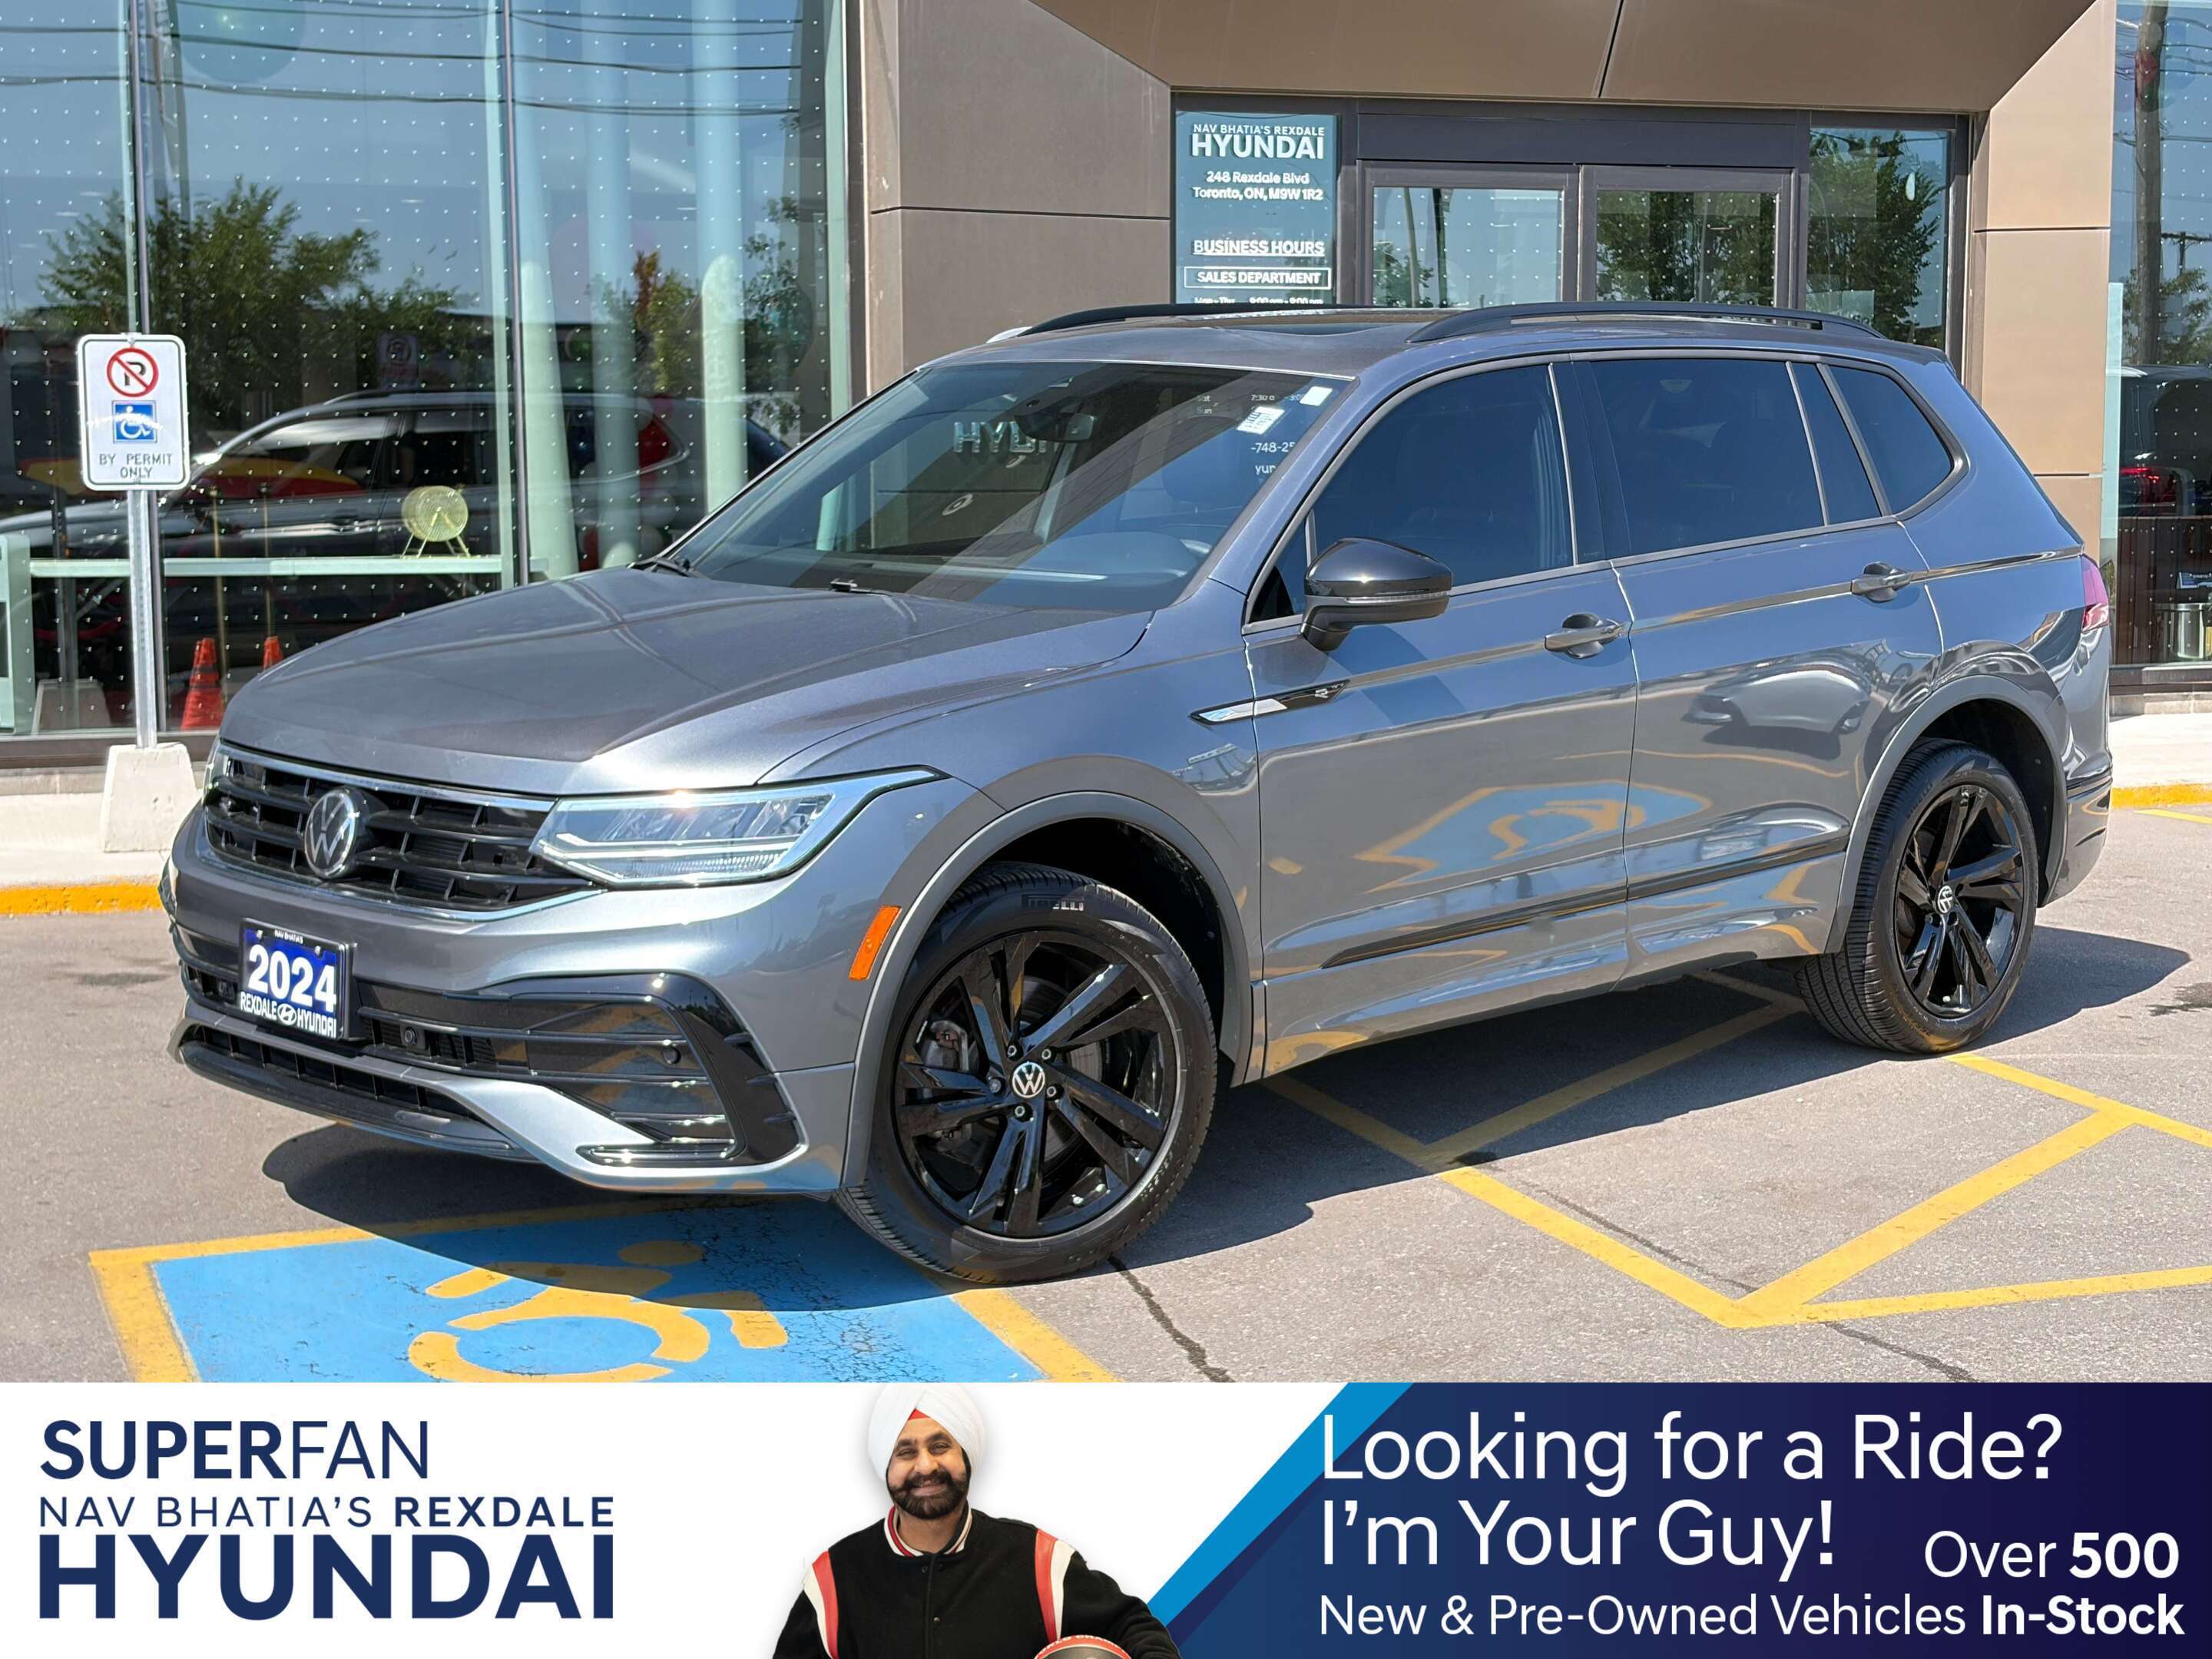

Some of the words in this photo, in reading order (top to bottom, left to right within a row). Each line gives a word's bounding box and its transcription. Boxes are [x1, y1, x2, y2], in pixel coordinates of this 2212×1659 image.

[1194, 124, 1217, 134] NAV
[1220, 124, 1270, 134] BHATIA'S
[1274, 126, 1325, 136] REXDALE
[1192, 134, 1323, 159] HYUNDAI
[1207, 171, 1230, 183] 248
[1233, 171, 1280, 184] Rexdale
[1283, 172, 1310, 184] Blvd
[1193, 187, 1242, 200] Toronto,
[1244, 187, 1267, 201] ON,
[1269, 188, 1300, 200] M9W
[1302, 189, 1323, 200] 1R2
[1193, 239, 1268, 255] BUSINESS
[1272, 241, 1325, 256] HOURS
[1197, 271, 1237, 283] SALES
[1239, 272, 1321, 284] DEPARTMENT
[99, 453, 116, 465] BY
[127, 453, 173, 465] PERMIT
[120, 467, 153, 478] ONLY
[247, 944, 337, 1013] 2024
[240, 991, 277, 1020] REXDALE
[296, 1008, 337, 1039] HYUNDAI
